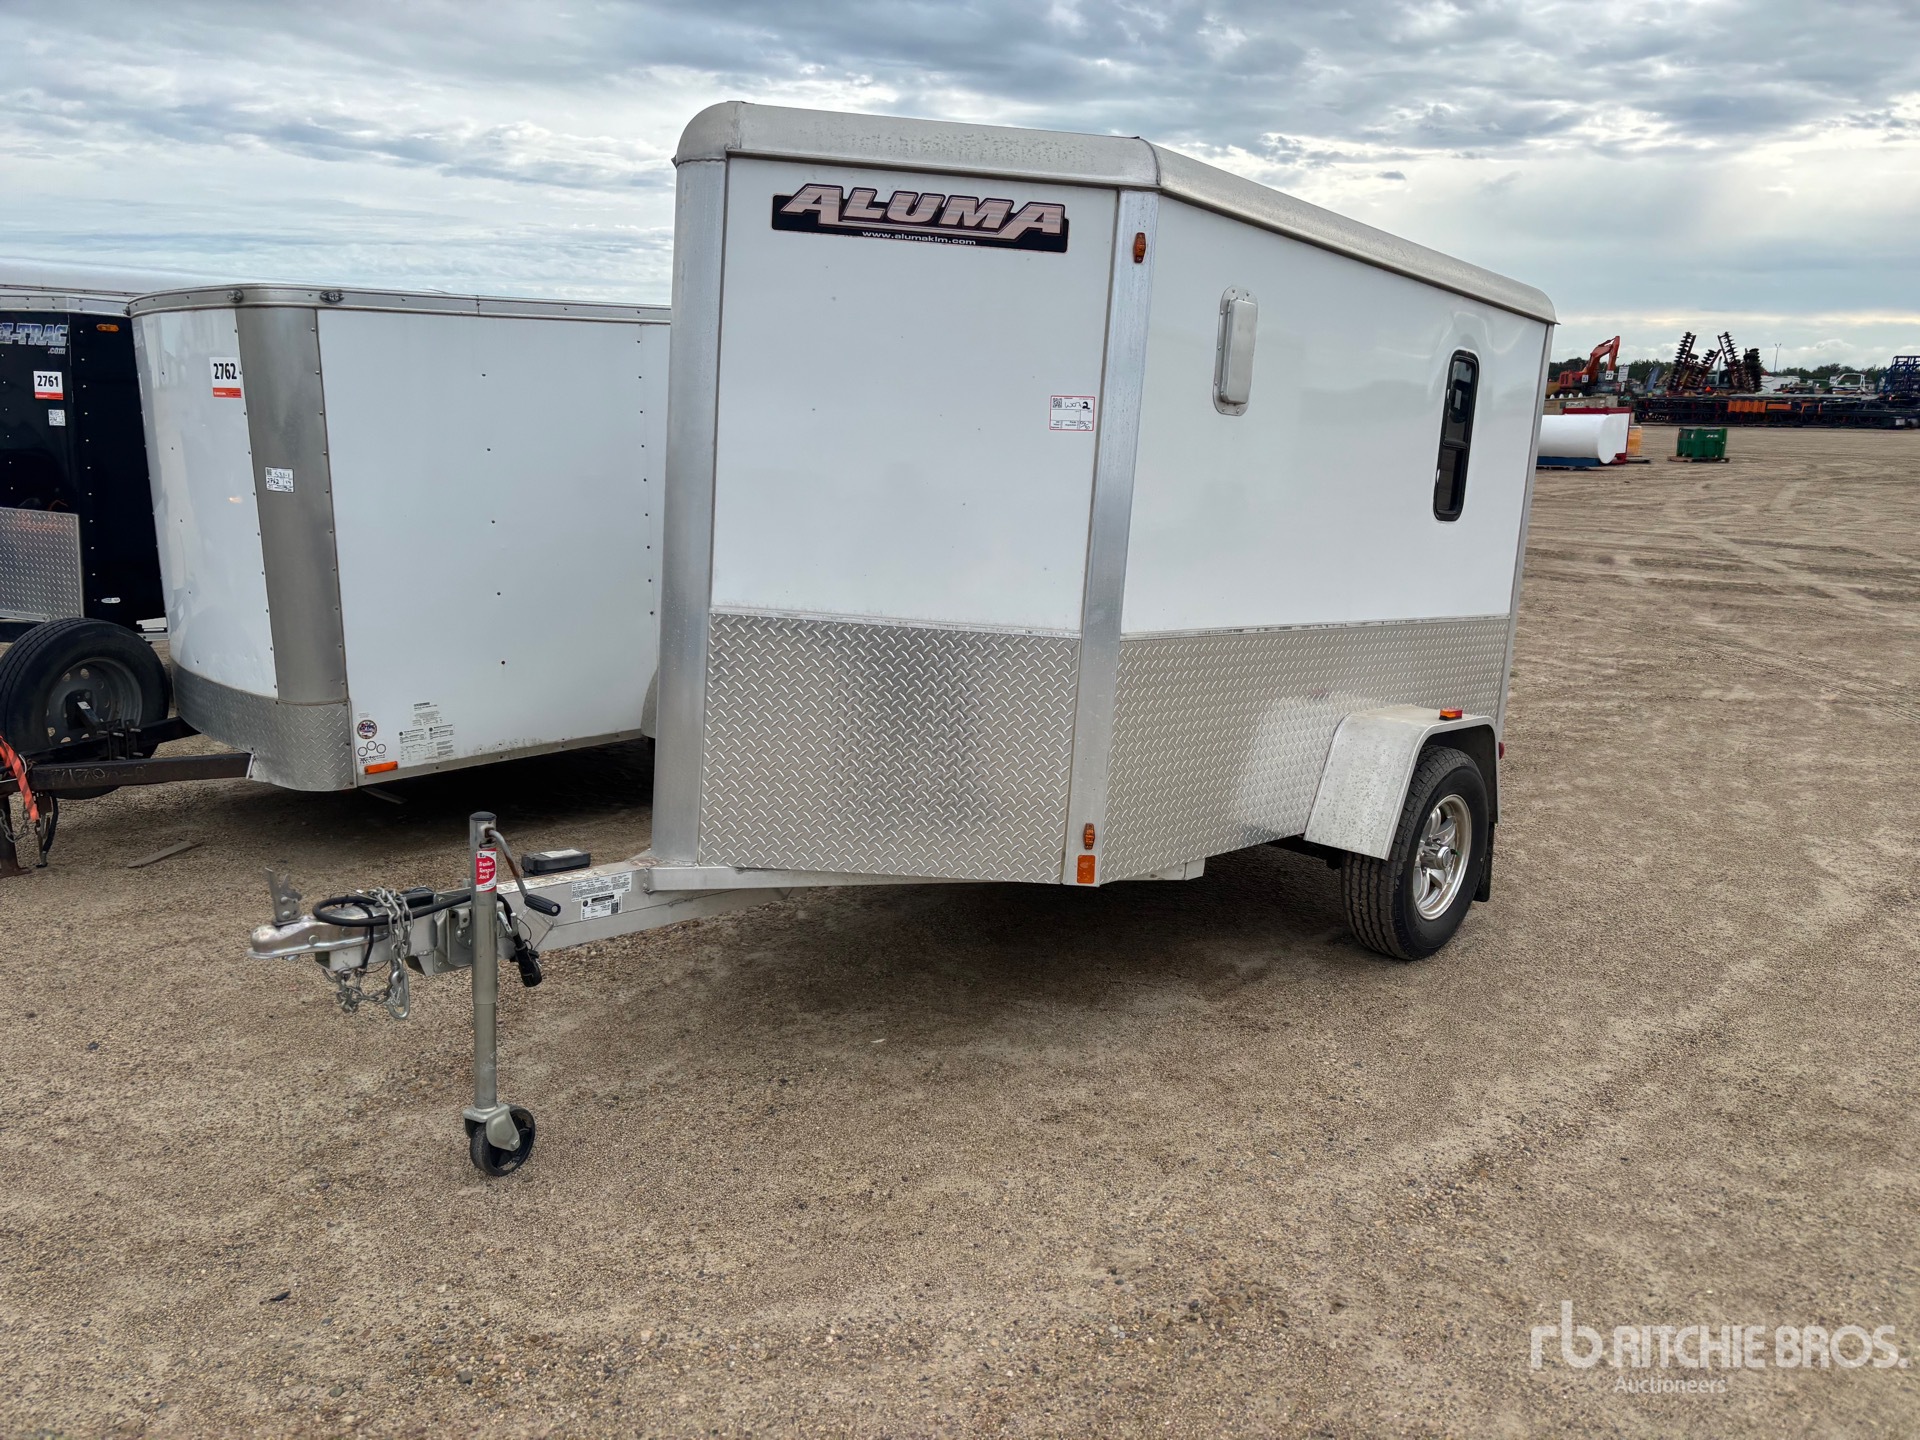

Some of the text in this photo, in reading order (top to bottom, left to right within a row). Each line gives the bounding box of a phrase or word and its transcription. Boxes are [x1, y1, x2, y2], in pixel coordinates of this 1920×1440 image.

[779, 184, 1065, 242] ALUMA
[213, 362, 238, 380] 2762
[37, 375, 59, 388] 2761
